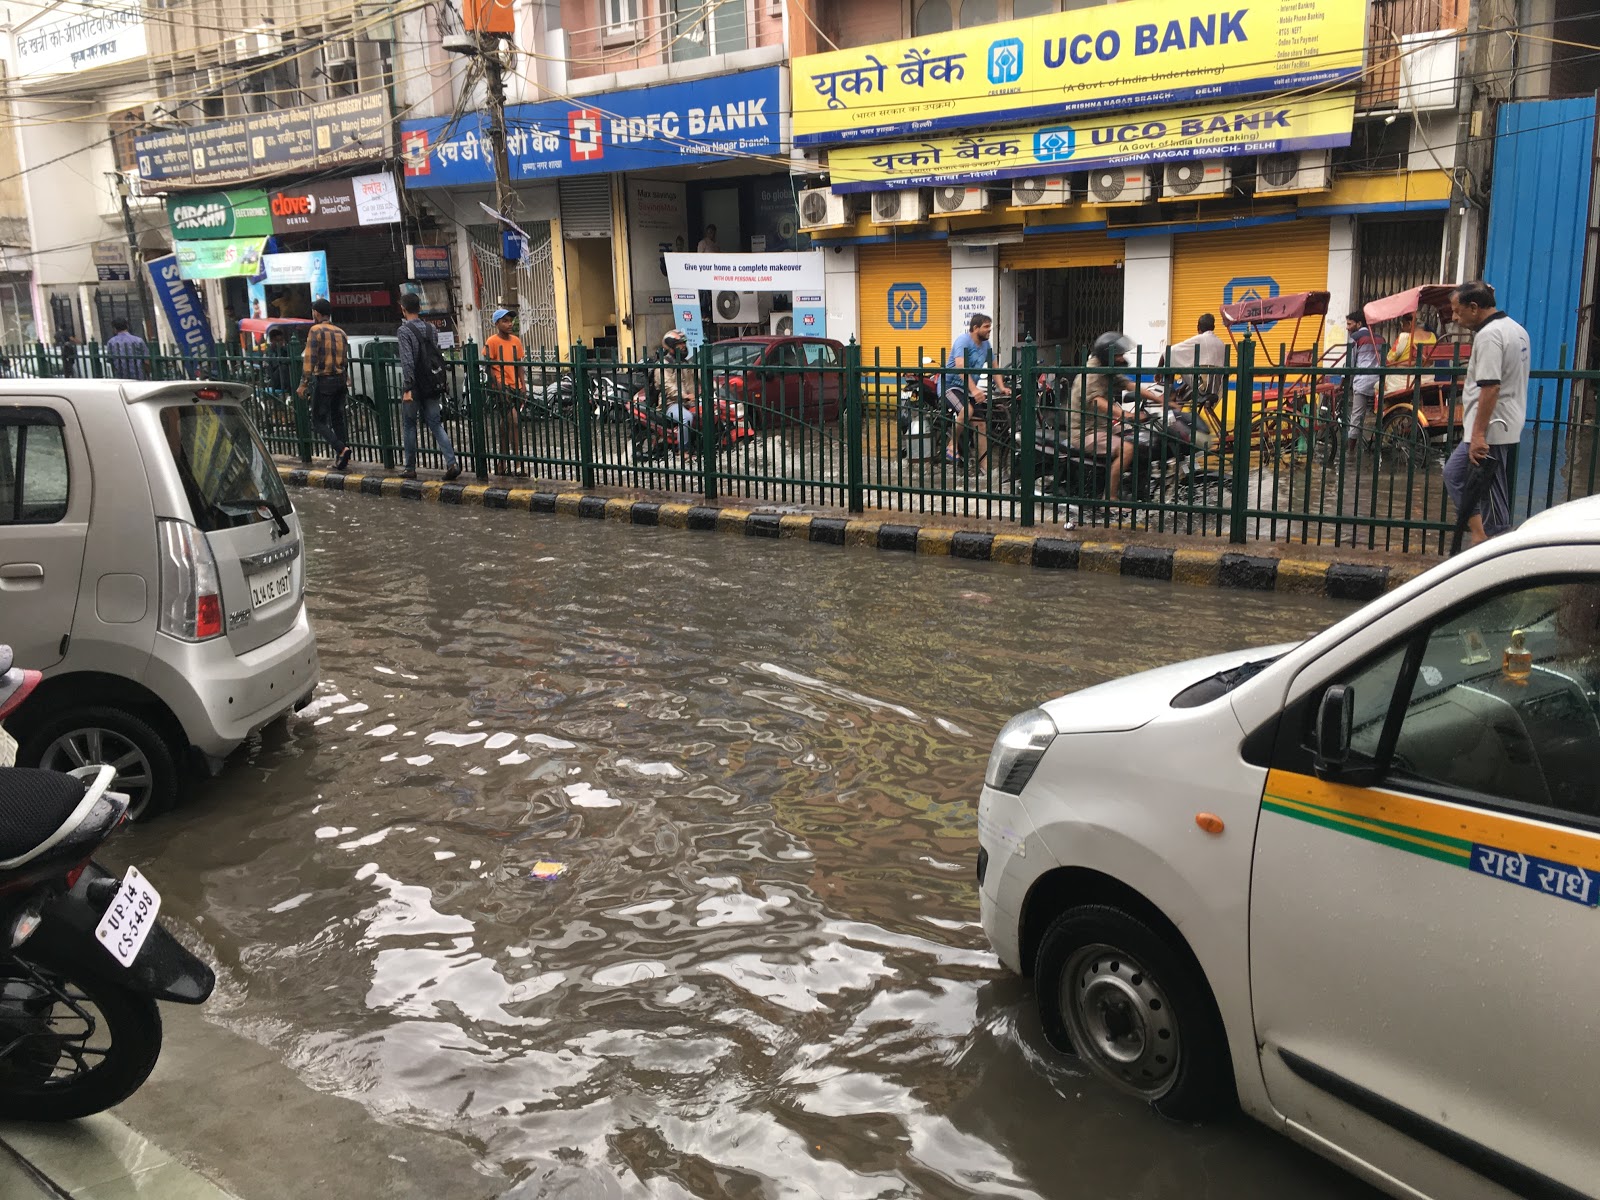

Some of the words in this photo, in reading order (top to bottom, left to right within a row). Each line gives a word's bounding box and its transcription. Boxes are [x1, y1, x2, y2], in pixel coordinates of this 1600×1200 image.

[1298, 2, 1315, 10] Banking
[1307, 12, 1325, 21] Banking
[1043, 29, 1121, 69] UCO
[1134, 8, 1250, 57] BANK
[1300, 35, 1319, 45] Payment
[1303, 47, 1319, 56] Trading
[1276, 63, 1291, 71] Locker
[810, 55, 888, 110] यूको
[896, 48, 968, 88] बैंक
[1077, 81, 1105, 91] Govt.
[1108, 79, 1119, 87] of
[1122, 76, 1148, 86] India
[1151, 63, 1226, 81] Undertaking)
[1065, 101, 1102, 111] KRISHNA
[1103, 97, 1133, 107] NAGAR
[1195, 86, 1222, 95] DELHI
[313, 102, 336, 119] PLASTIC
[337, 99, 362, 116] SURGERY
[362, 94, 382, 110] CLINIC
[879, 107, 906, 117] सरकार
[908, 105, 920, 115] का
[331, 122, 341, 134] Dr.
[341, 118, 360, 132] Manoj
[360, 115, 382, 129] Bansal
[610, 111, 680, 144] HDFC
[688, 97, 769, 136] BANK
[1091, 122, 1167, 146] UCO
[1181, 109, 1292, 137] BANK
[841, 130, 858, 139] कृष्णा
[911, 120, 933, 130] दिल्ली
[531, 122, 561, 153] बैंक
[1131, 142, 1156, 152] Govt.
[1158, 140, 1169, 149] of
[1170, 138, 1193, 147] India
[1195, 131, 1260, 145] Undertaking)
[680, 143, 711, 156] Krishna
[712, 140, 737, 153] Nagar
[739, 135, 770, 149] Branch
[951, 137, 1022, 160] बैंक
[1108, 153, 1150, 164] KRISHNA
[1153, 149, 1190, 159] NAGAR
[1244, 142, 1276, 151] DELHI
[338, 149, 358, 161] Plastic
[358, 146, 383, 160] Surgery
[911, 176, 932, 184] नगर
[934, 174, 959, 182] शाखा
[319, 196, 333, 205] India's
[333, 195, 350, 205] Largest
[637, 189, 651, 198] Max
[652, 191, 677, 201] savings
[761, 190, 771, 201] Go
[773, 189, 793, 201] globa
[235, 207, 267, 218] ELECTRONICS
[321, 206, 337, 214] Dental
[337, 204, 351, 213] Chain
[286, 217, 309, 225] DENTAL
[684, 263, 697, 271] Give
[699, 264, 712, 272] your
[713, 263, 731, 271] home
[738, 264, 768, 273] complete
[769, 263, 802, 272] makeover
[336, 293, 372, 305] HITACHI
[1479, 847, 1530, 884] राधे
[1537, 865, 1593, 902] राधे
